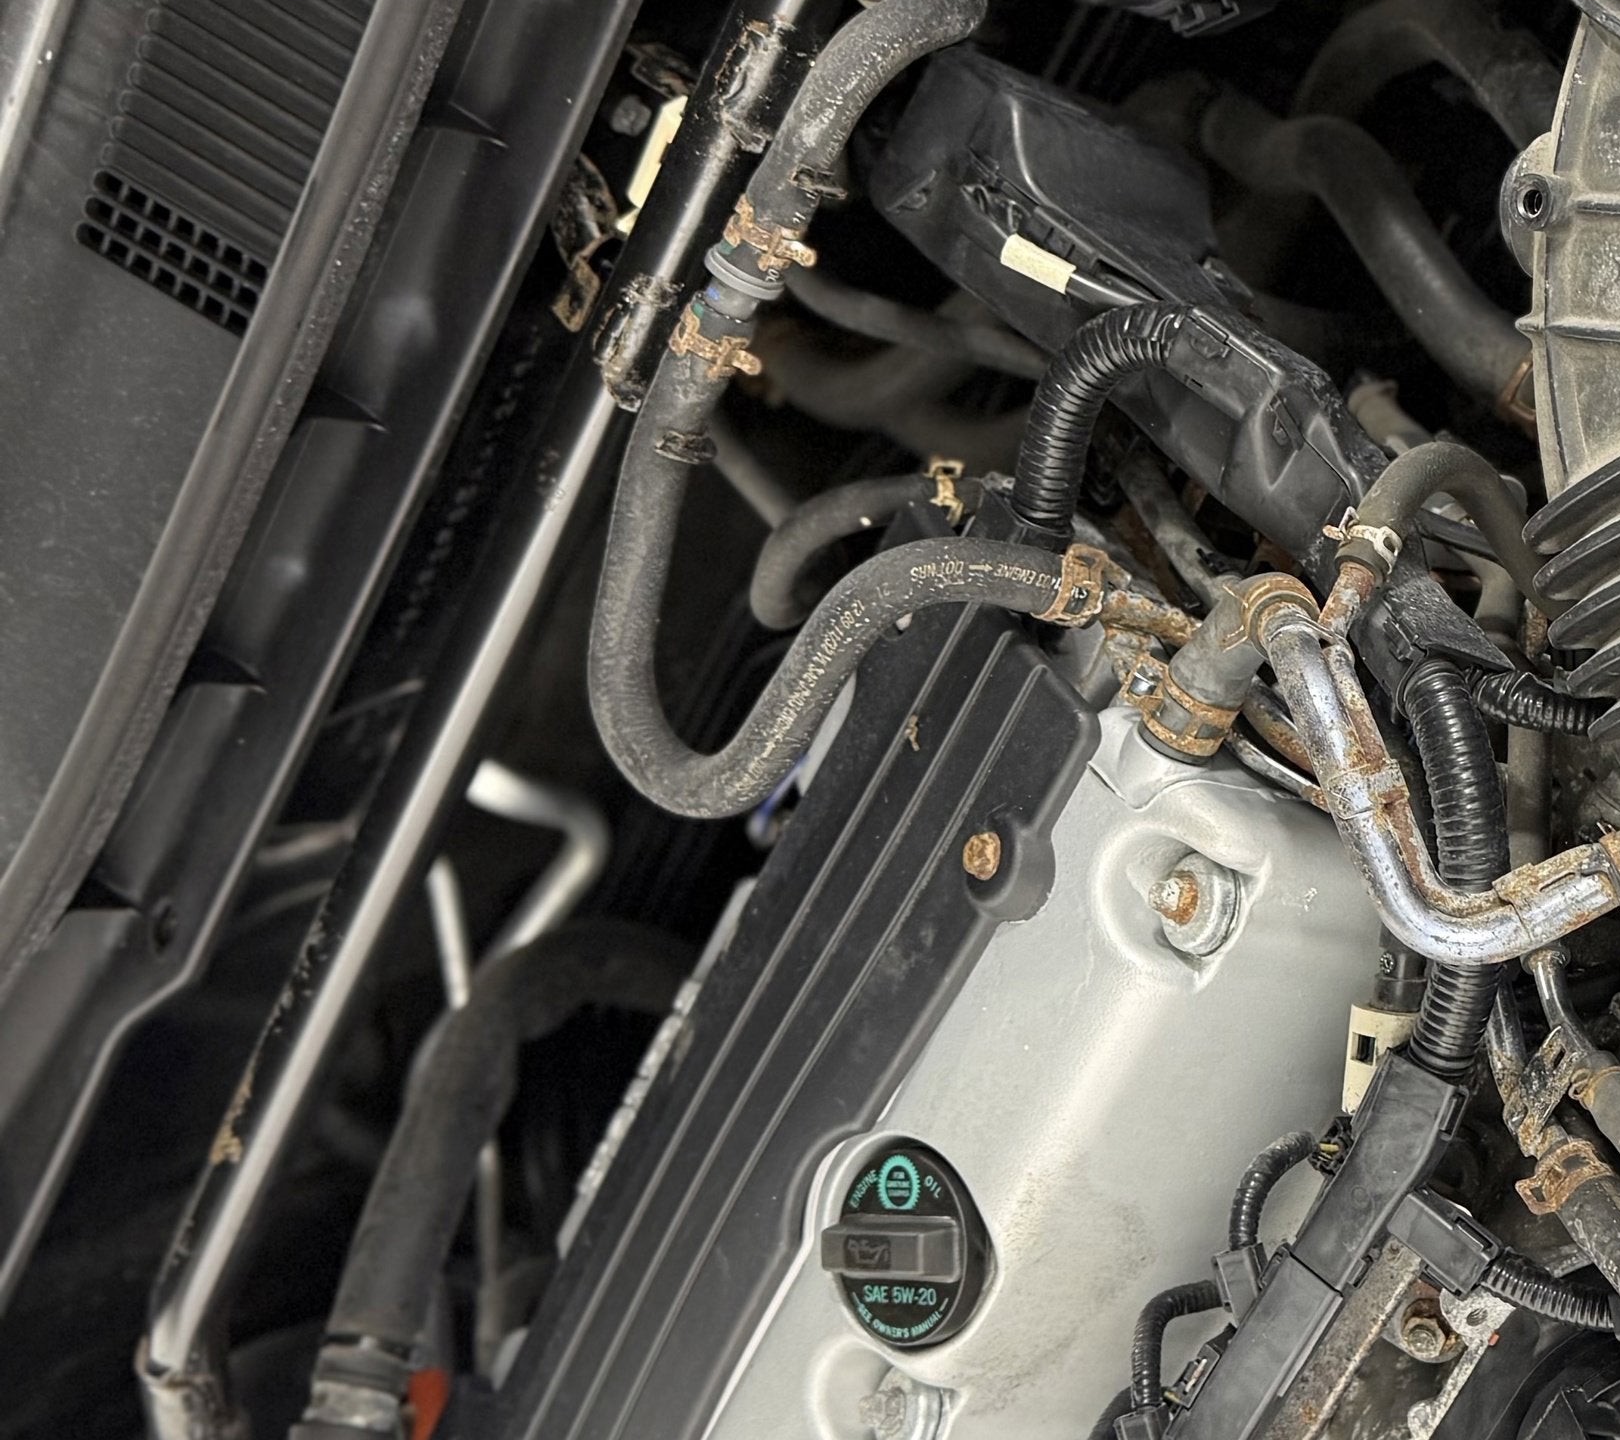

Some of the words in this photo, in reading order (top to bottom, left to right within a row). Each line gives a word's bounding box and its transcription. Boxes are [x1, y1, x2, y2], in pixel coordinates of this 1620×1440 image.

[849, 1169, 878, 1207] ENGINE
[924, 1175, 941, 1198] OIL
[863, 1284, 888, 1302] SAE
[892, 1286, 936, 1305] 5W-20
